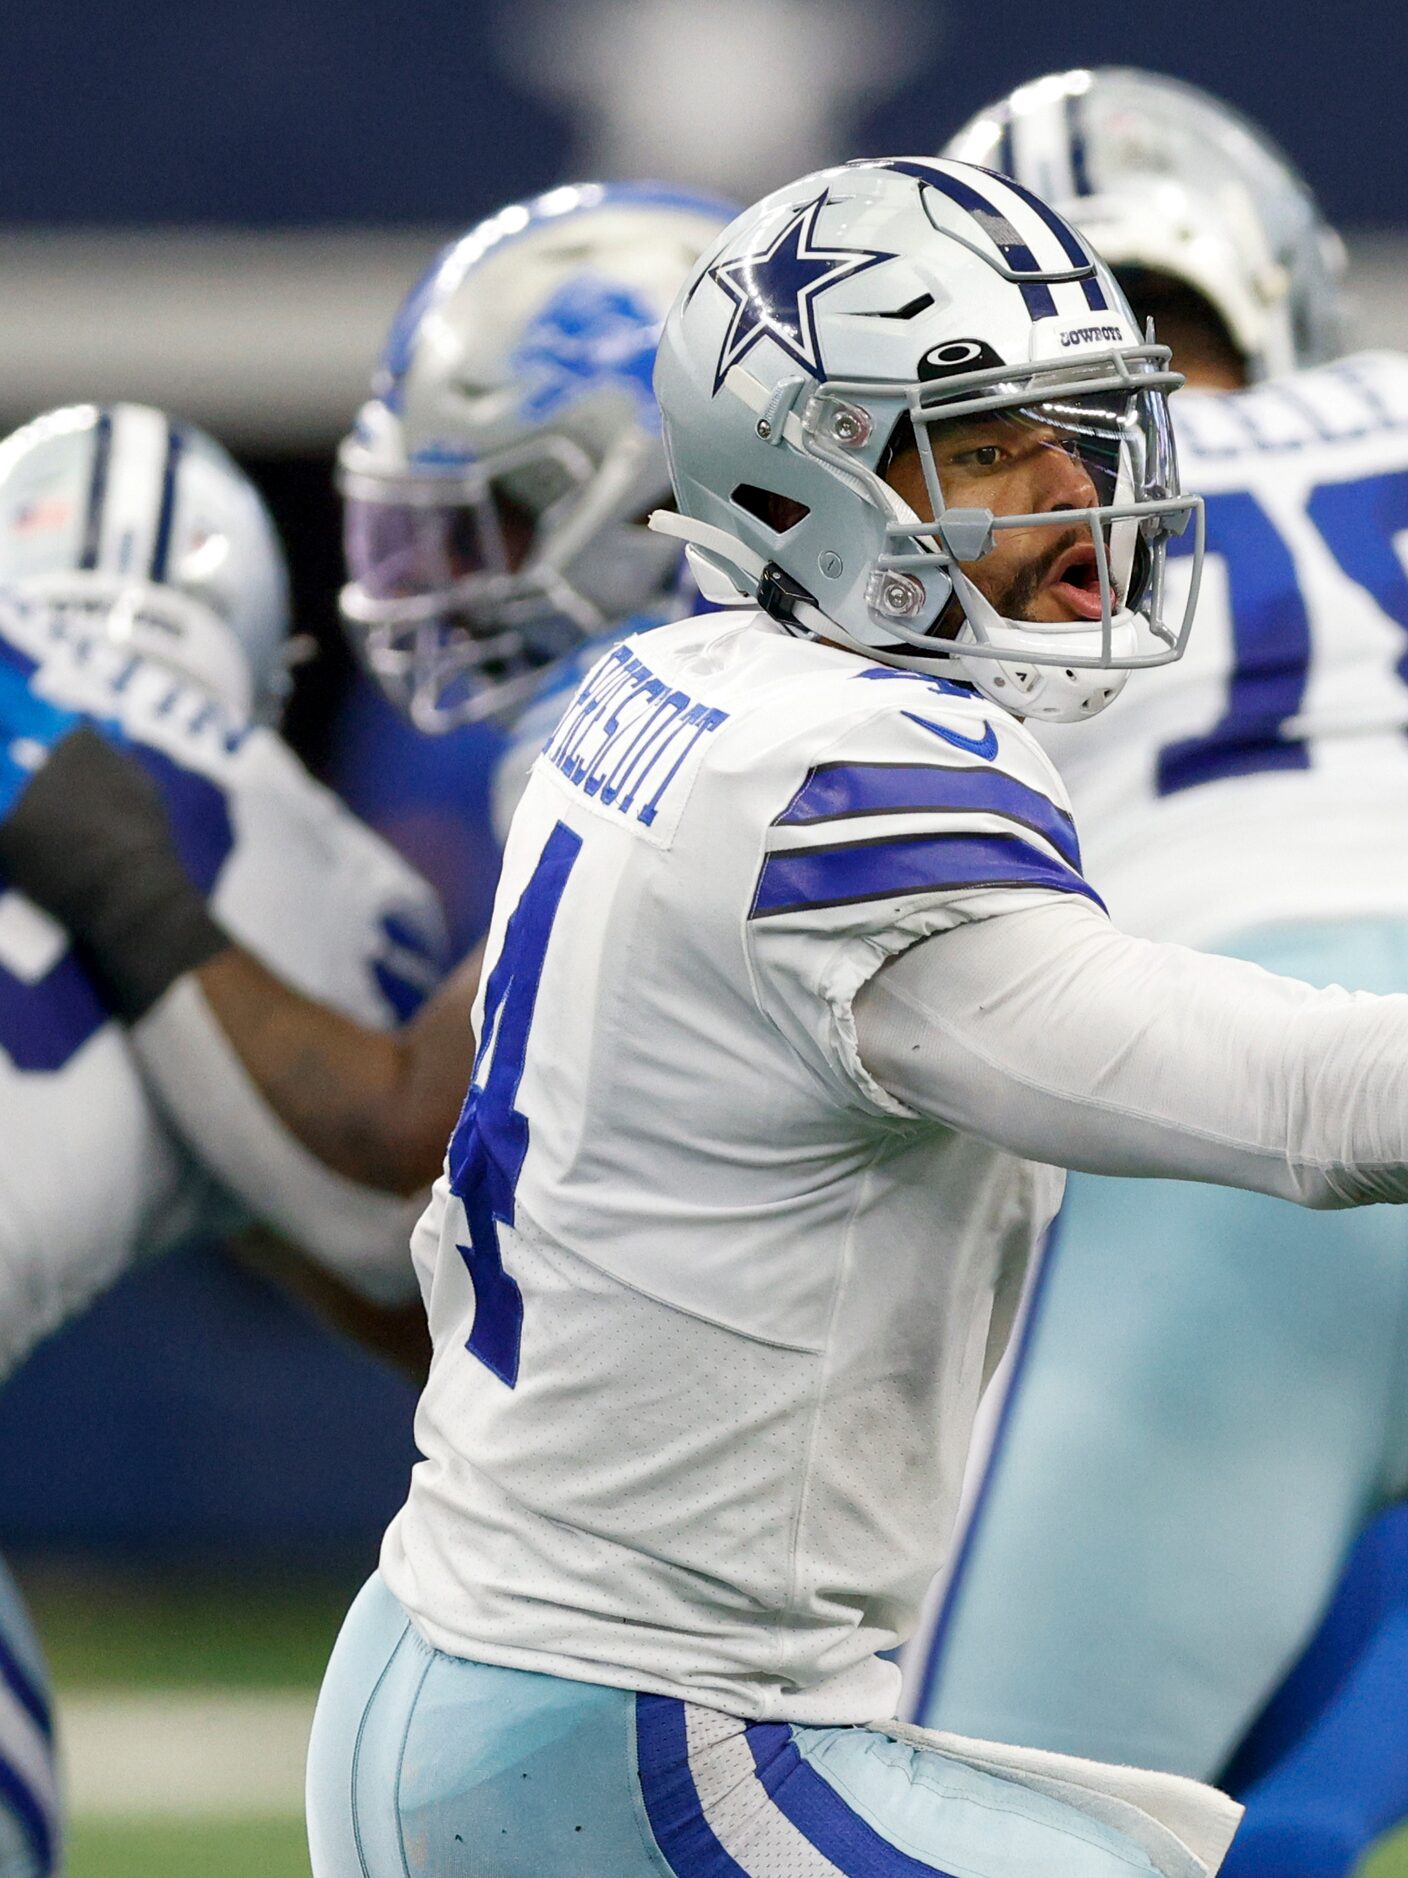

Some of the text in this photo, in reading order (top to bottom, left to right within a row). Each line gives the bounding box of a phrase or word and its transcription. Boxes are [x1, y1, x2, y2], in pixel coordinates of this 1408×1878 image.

[1060, 326, 1122, 347] COWBOYS
[541, 645, 730, 827] PRESCOTT
[448, 818, 583, 1389] 4
